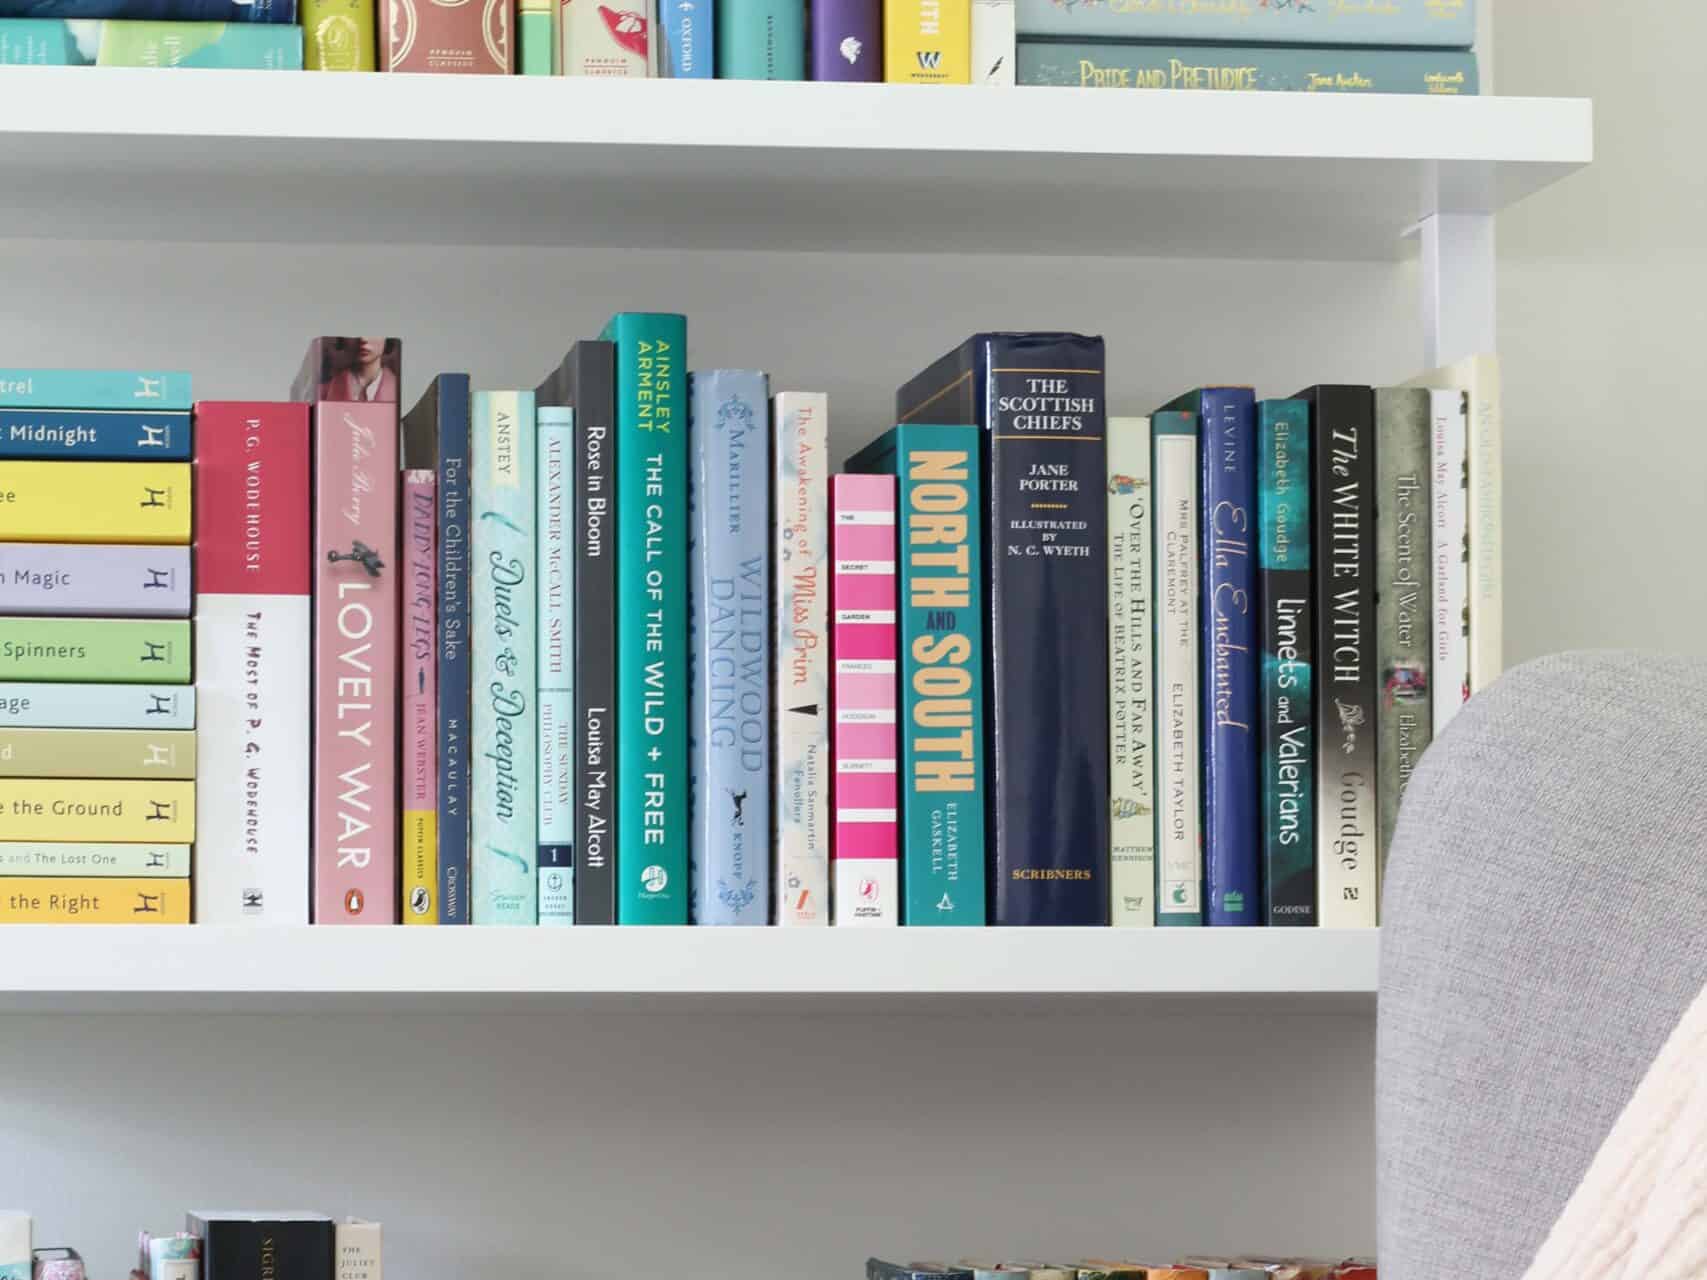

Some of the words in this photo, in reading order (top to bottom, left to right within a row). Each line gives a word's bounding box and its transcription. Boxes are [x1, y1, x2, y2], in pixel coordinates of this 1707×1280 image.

[1080, 60, 1130, 90] PRIDE
[1136, 70, 1166, 90] AND
[1169, 59, 1257, 90] PREJUDICE
[638, 340, 654, 432] ARMENT
[656, 341, 671, 433] AINSLEY
[999, 397, 1095, 413] SCOTTISH
[1026, 379, 1068, 394] THE
[11, 426, 96, 444] Midnight
[498, 412, 512, 474] ANSTEY
[587, 427, 605, 470] Rose
[796, 408, 813, 434] The
[1012, 415, 1083, 431] CHIEFS
[1224, 405, 1236, 473] LEVINE
[445, 457, 461, 484] For
[647, 454, 662, 496] THE
[1028, 464, 1070, 476] JANE
[1333, 428, 1358, 476] The
[445, 489, 462, 518] the
[587, 476, 604, 491] in
[726, 430, 744, 535] MARILLIER
[794, 444, 812, 532] Awakening
[1019, 479, 1079, 492] PORTER
[1398, 472, 1418, 507] The
[586, 498, 606, 557] Bloom
[647, 505, 662, 562] CALL
[796, 540, 812, 556] of
[908, 450, 970, 608] NORTH
[1007, 545, 1022, 556] N.
[1025, 545, 1040, 556] C.
[1043, 545, 1090, 557] WYETH
[1010, 520, 1088, 530] ILLUSTRATED
[1041, 533, 1057, 542] BY
[1114, 533, 1125, 561] THE
[1213, 501, 1248, 568] Ella
[1334, 483, 1358, 576] WHITE
[1398, 512, 1416, 563] Scent
[15, 570, 69, 587] Magic
[445, 525, 462, 612] Children's
[490, 551, 525, 639] Duels
[647, 571, 663, 600] OF
[792, 567, 816, 625] Miss
[1114, 567, 1125, 598] LIFE
[1393, 568, 1419, 587] of
[445, 619, 461, 661] Sake
[647, 608, 662, 651] THE
[925, 610, 956, 631] AND
[1276, 598, 1307, 688] Linnets
[1334, 590, 1360, 681] WITCH
[1397, 591, 1416, 646] Water
[4, 642, 85, 661] Spinners
[338, 583, 372, 746] LOVELY
[710, 578, 737, 749] DANCING
[740, 556, 762, 773] WILDWOOD
[785, 627, 818, 685] Prim
[1114, 624, 1125, 694] BEATRIX
[1213, 582, 1248, 732] Enchanted
[415, 703, 426, 735] JEAN
[645, 660, 664, 736] WILD
[908, 634, 975, 792] SOUTH
[1278, 697, 1293, 723] and
[485, 682, 525, 823] Deception
[586, 708, 606, 764] Louisa
[1114, 699, 1125, 764] POTTER
[1173, 684, 1184, 773] ELIZABETH
[415, 739, 427, 801] WEBSTER
[447, 720, 458, 817] MACAULAY
[585, 772, 606, 809] May
[1278, 726, 1306, 844] Valerians
[14, 800, 43, 814] the
[52, 801, 122, 816] Ground
[338, 763, 371, 868] WAR
[644, 771, 664, 845] FREE
[1173, 779, 1184, 840] TAYLOR
[1336, 770, 1365, 871] Goudge
[586, 815, 606, 867] Alcott
[930, 809, 944, 874] GASKELL
[945, 801, 957, 881] ELIZABETH
[1012, 868, 1091, 880] SCRIBNERS
[11, 895, 40, 909] the
[49, 895, 98, 913] Right
